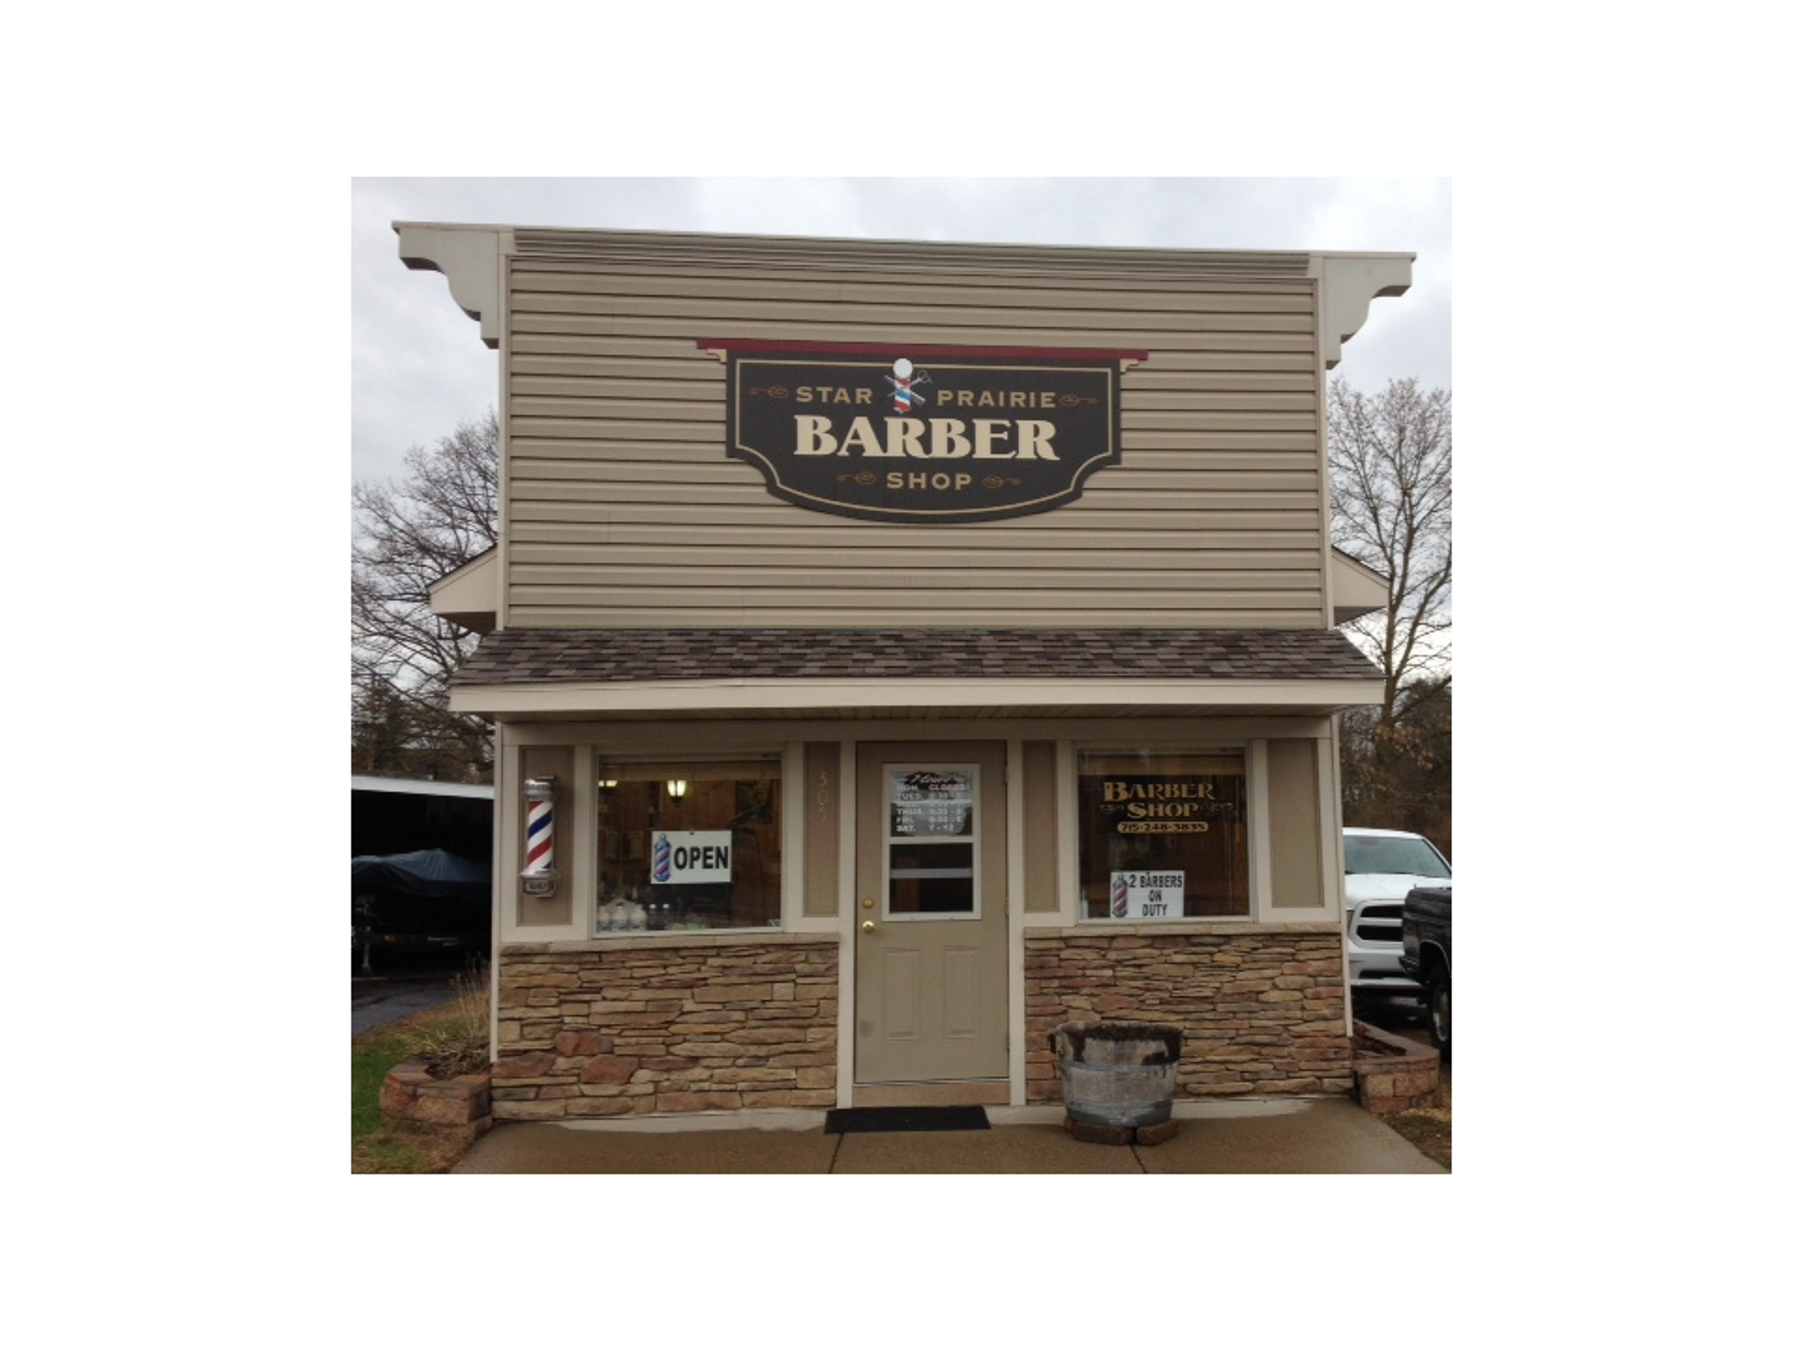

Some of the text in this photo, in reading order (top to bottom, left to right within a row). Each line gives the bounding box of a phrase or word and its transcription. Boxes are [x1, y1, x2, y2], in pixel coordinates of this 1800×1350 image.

[796, 386, 1056, 408] STAR PRAIRIE
[793, 414, 1061, 461] BARBER
[886, 472, 972, 490] SHOP
[1103, 781, 1215, 801] BARBER
[1127, 802, 1198, 819] SHOP
[673, 846, 729, 871] OPEN
[1128, 874, 1183, 888] 2 BARBERS
[1148, 889, 1162, 902] ON
[1142, 904, 1168, 916] DUTY
